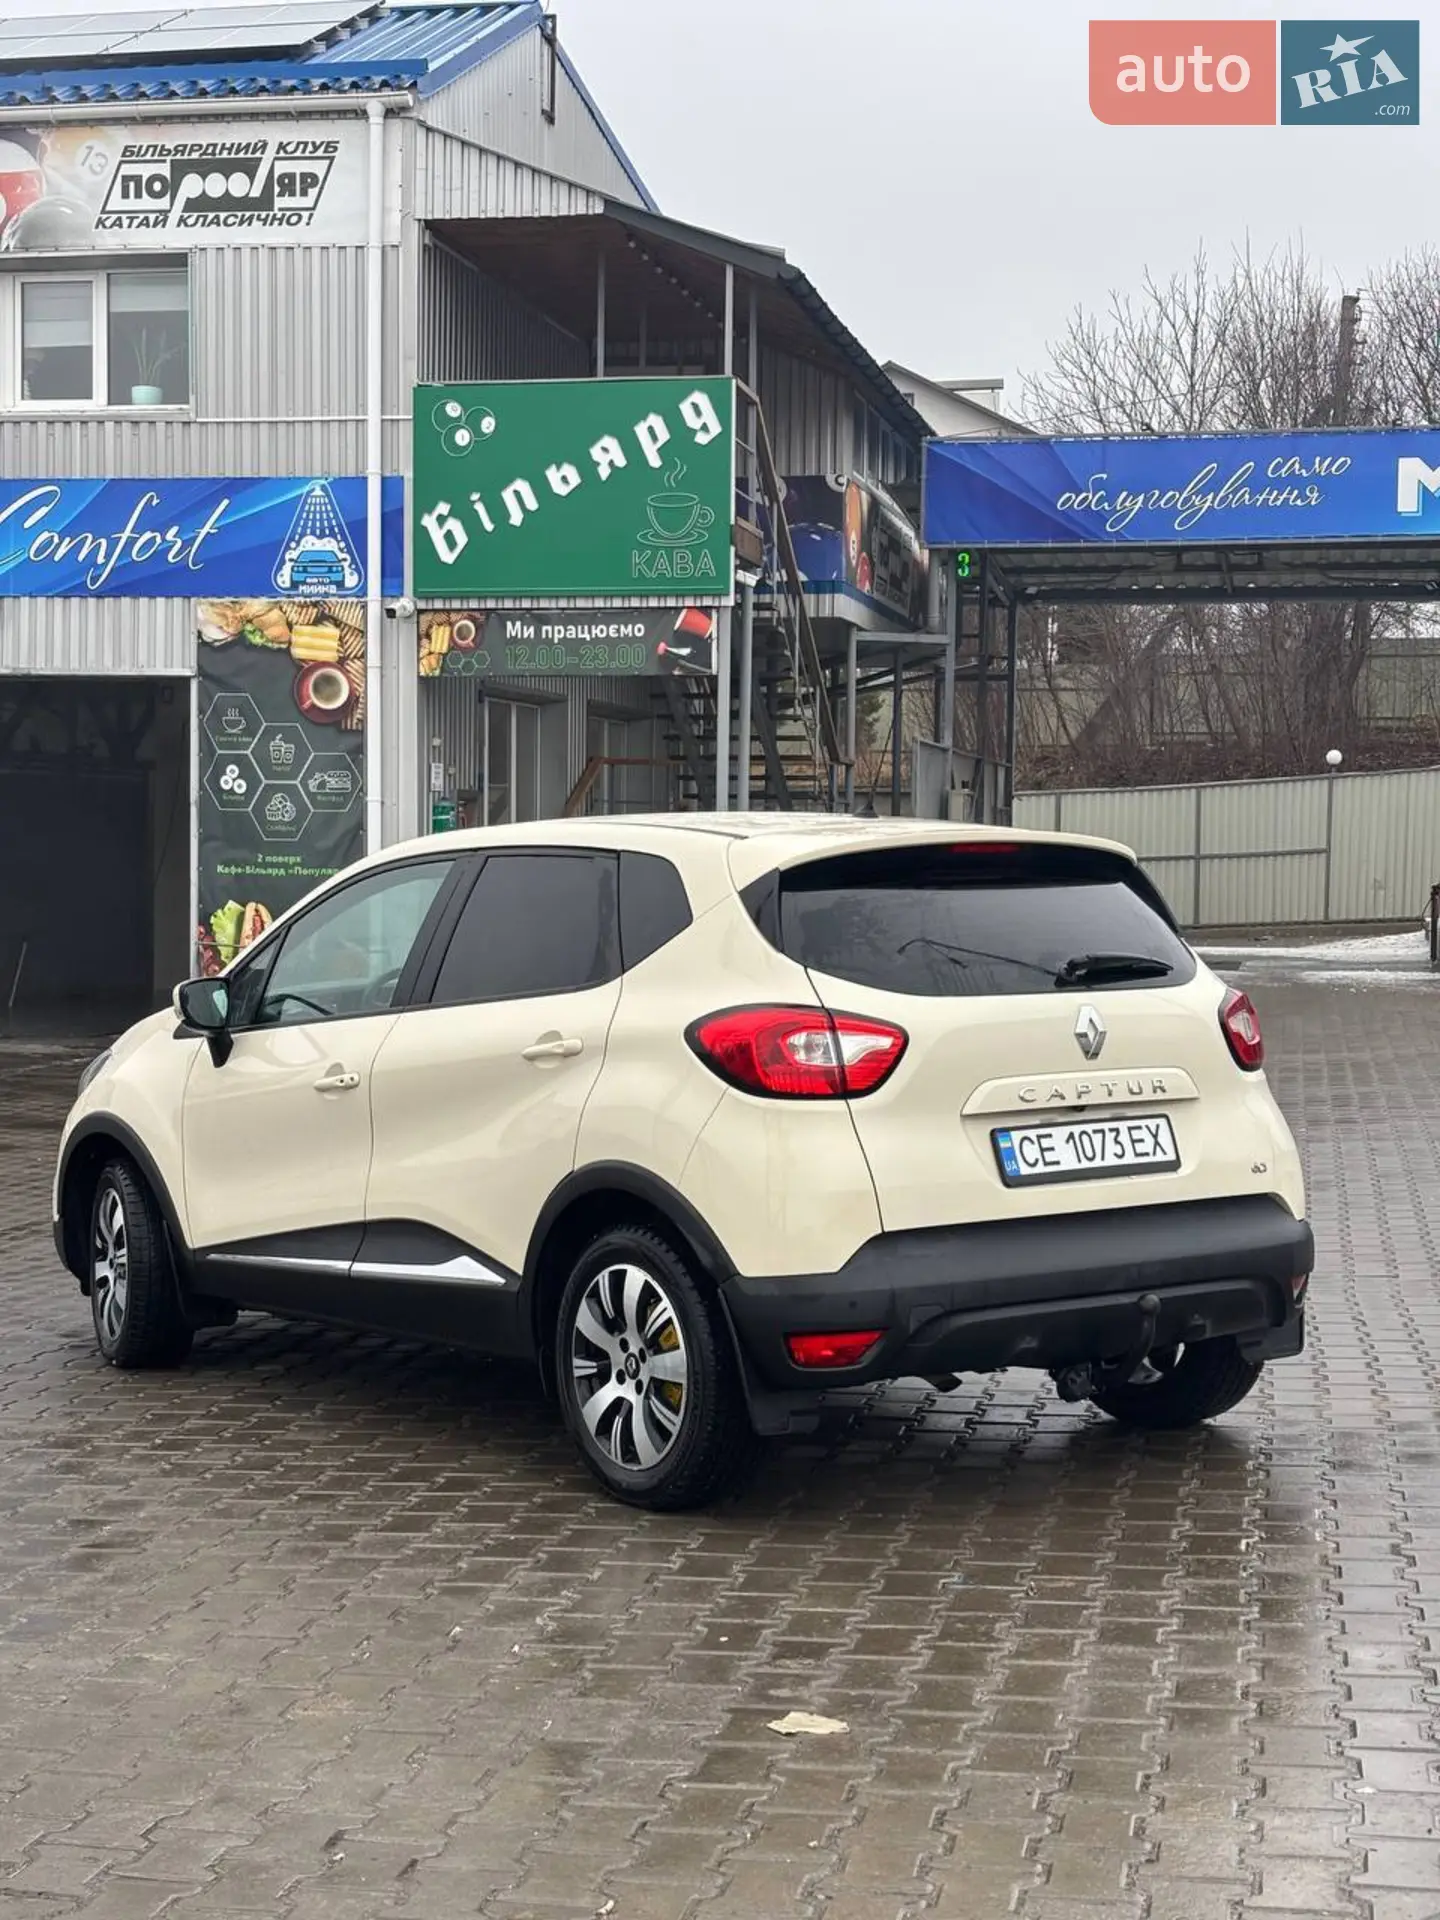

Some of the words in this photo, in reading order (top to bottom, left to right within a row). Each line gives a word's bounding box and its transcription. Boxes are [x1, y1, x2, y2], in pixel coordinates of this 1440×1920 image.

[80, 145, 109, 176] 13
[120, 139, 269, 158] БІЛЬЯРДНИЙ
[275, 140, 340, 155] КЛУБ
[94, 211, 170, 230] КАТАЙ
[1267, 454, 1351, 478] само
[1057, 462, 1325, 533] обслуговування
[0, 485, 230, 590] Comfort
[632, 548, 716, 578] КАВА
[958, 552, 970, 577] 3
[506, 620, 535, 639] Ми
[541, 622, 646, 644] працюємо
[1018, 1078, 1168, 1103] CAPTUR
[1019, 1133, 1061, 1168] CE
